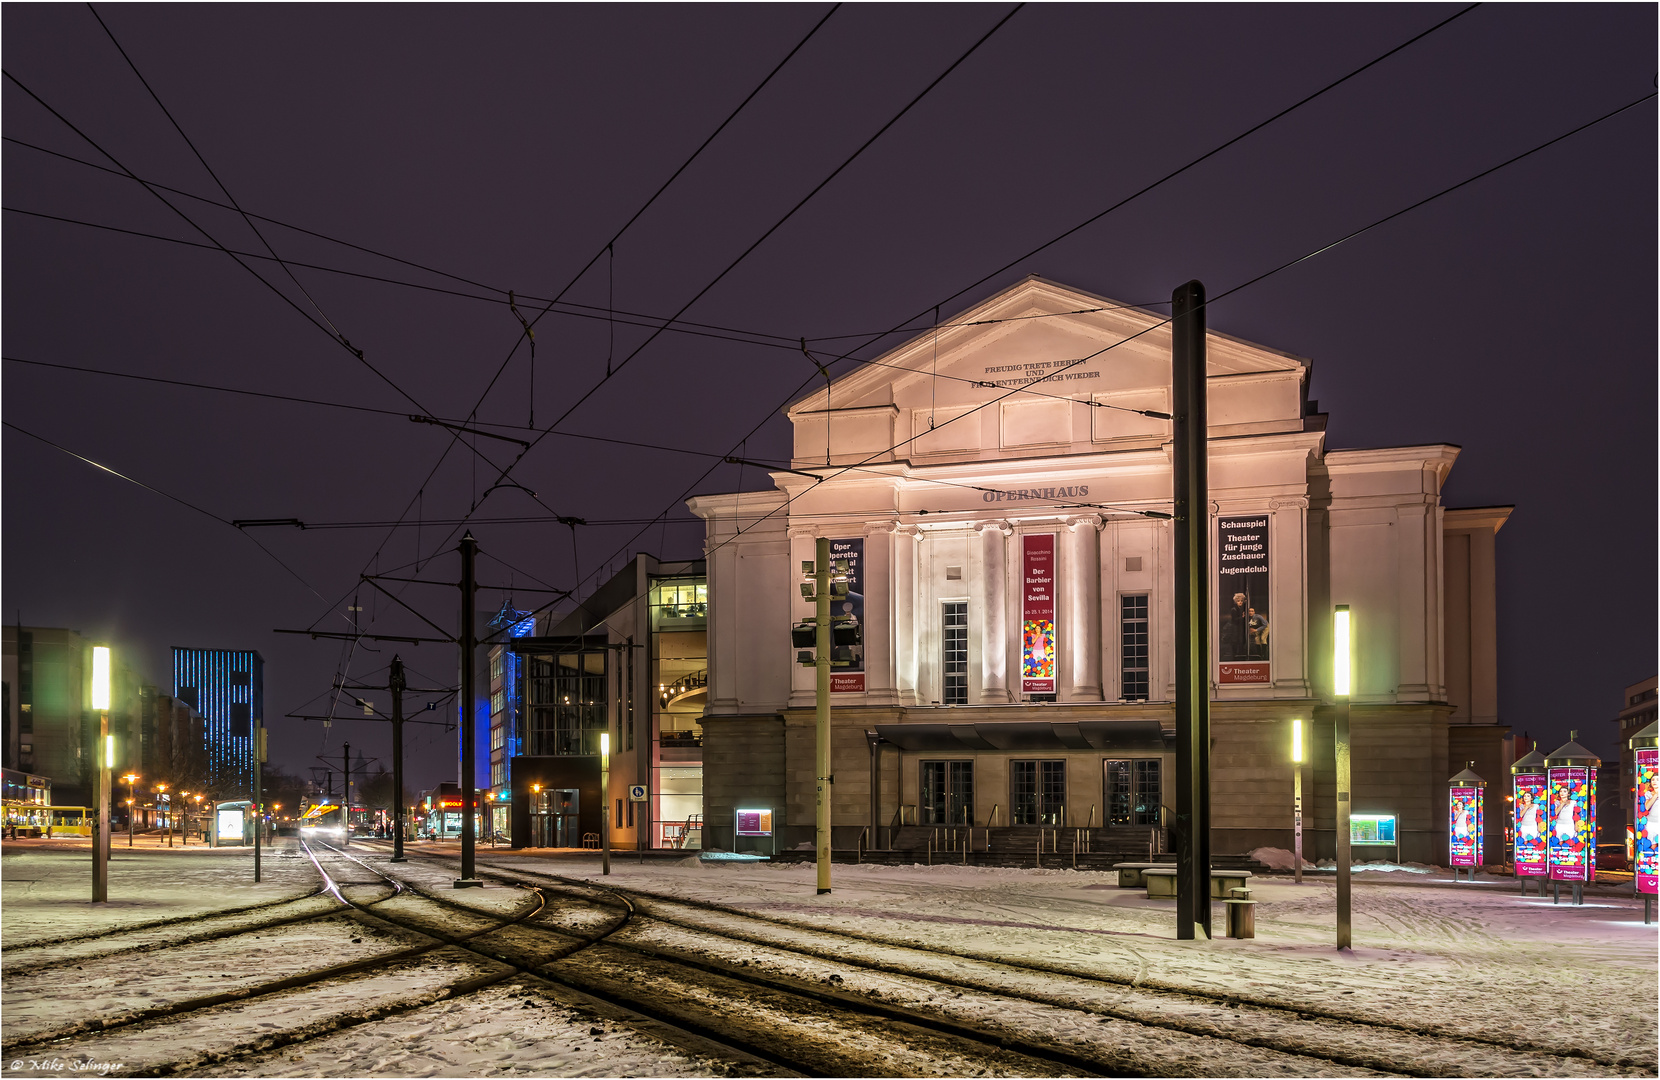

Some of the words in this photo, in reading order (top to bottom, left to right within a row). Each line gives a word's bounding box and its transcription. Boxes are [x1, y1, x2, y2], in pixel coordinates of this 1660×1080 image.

[985, 364, 1022, 374] FREUDIG
[1023, 362, 1052, 370] TRETE
[1065, 372, 1100, 380] WIEDER
[983, 486, 1088, 502] OPERNHAUS
[1221, 520, 1266, 528] Schauspiel
[1240, 544, 1262, 552] junge
[1220, 566, 1268, 575] Jugendclub
